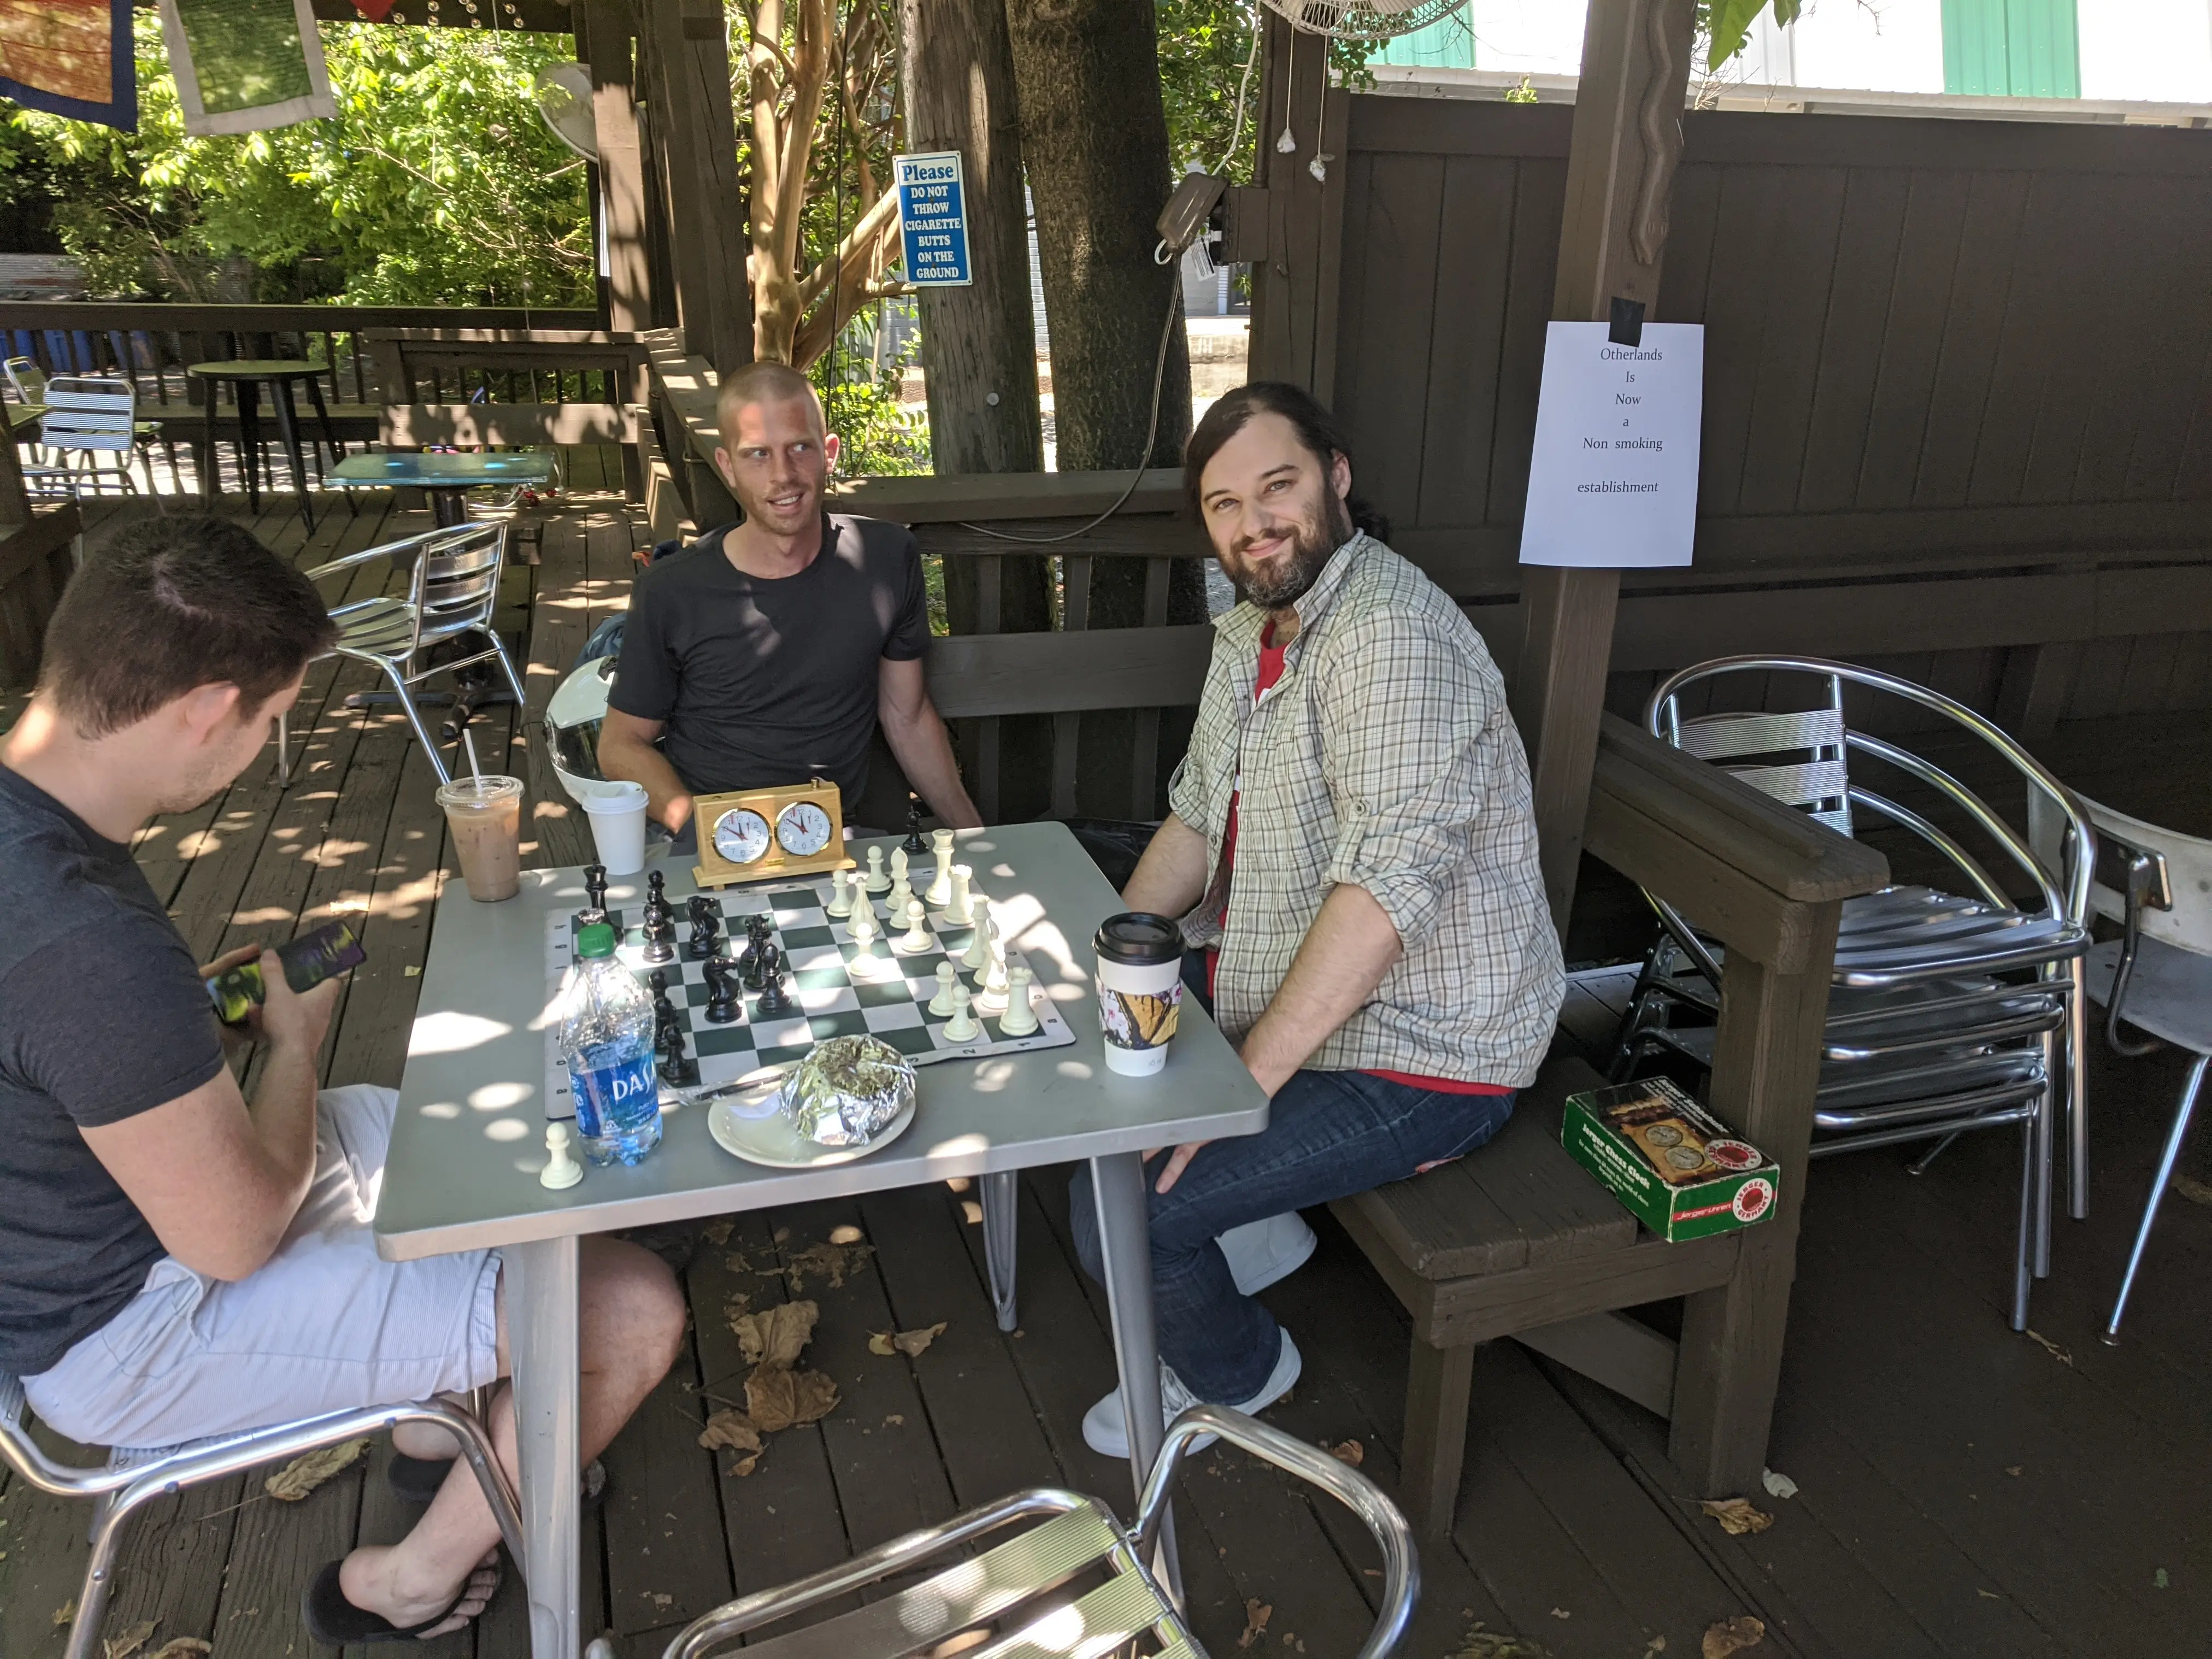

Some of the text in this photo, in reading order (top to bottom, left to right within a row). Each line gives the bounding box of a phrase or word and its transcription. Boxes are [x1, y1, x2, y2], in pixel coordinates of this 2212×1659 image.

[902, 164, 954, 181] Please
[910, 185, 949, 198] DO NOT
[912, 202, 950, 215] THROW
[905, 218, 961, 231] CIGARETTE
[917, 234, 951, 246] BUTTS
[917, 251, 955, 263] ON THE
[916, 267, 959, 279] GROUND
[1601, 348, 1663, 360] Otherlands
[1626, 370, 1636, 383] Is
[1615, 393, 1642, 405] Now
[1622, 419, 1629, 427] a
[1583, 437, 1663, 452] Non smoking
[1577, 480, 1659, 492] establishment
[1582, 1123, 1650, 1190] Jerger Chess Clock
[1737, 1181, 1764, 1201] JERGER
[1738, 1196, 1769, 1219] GERMANY
